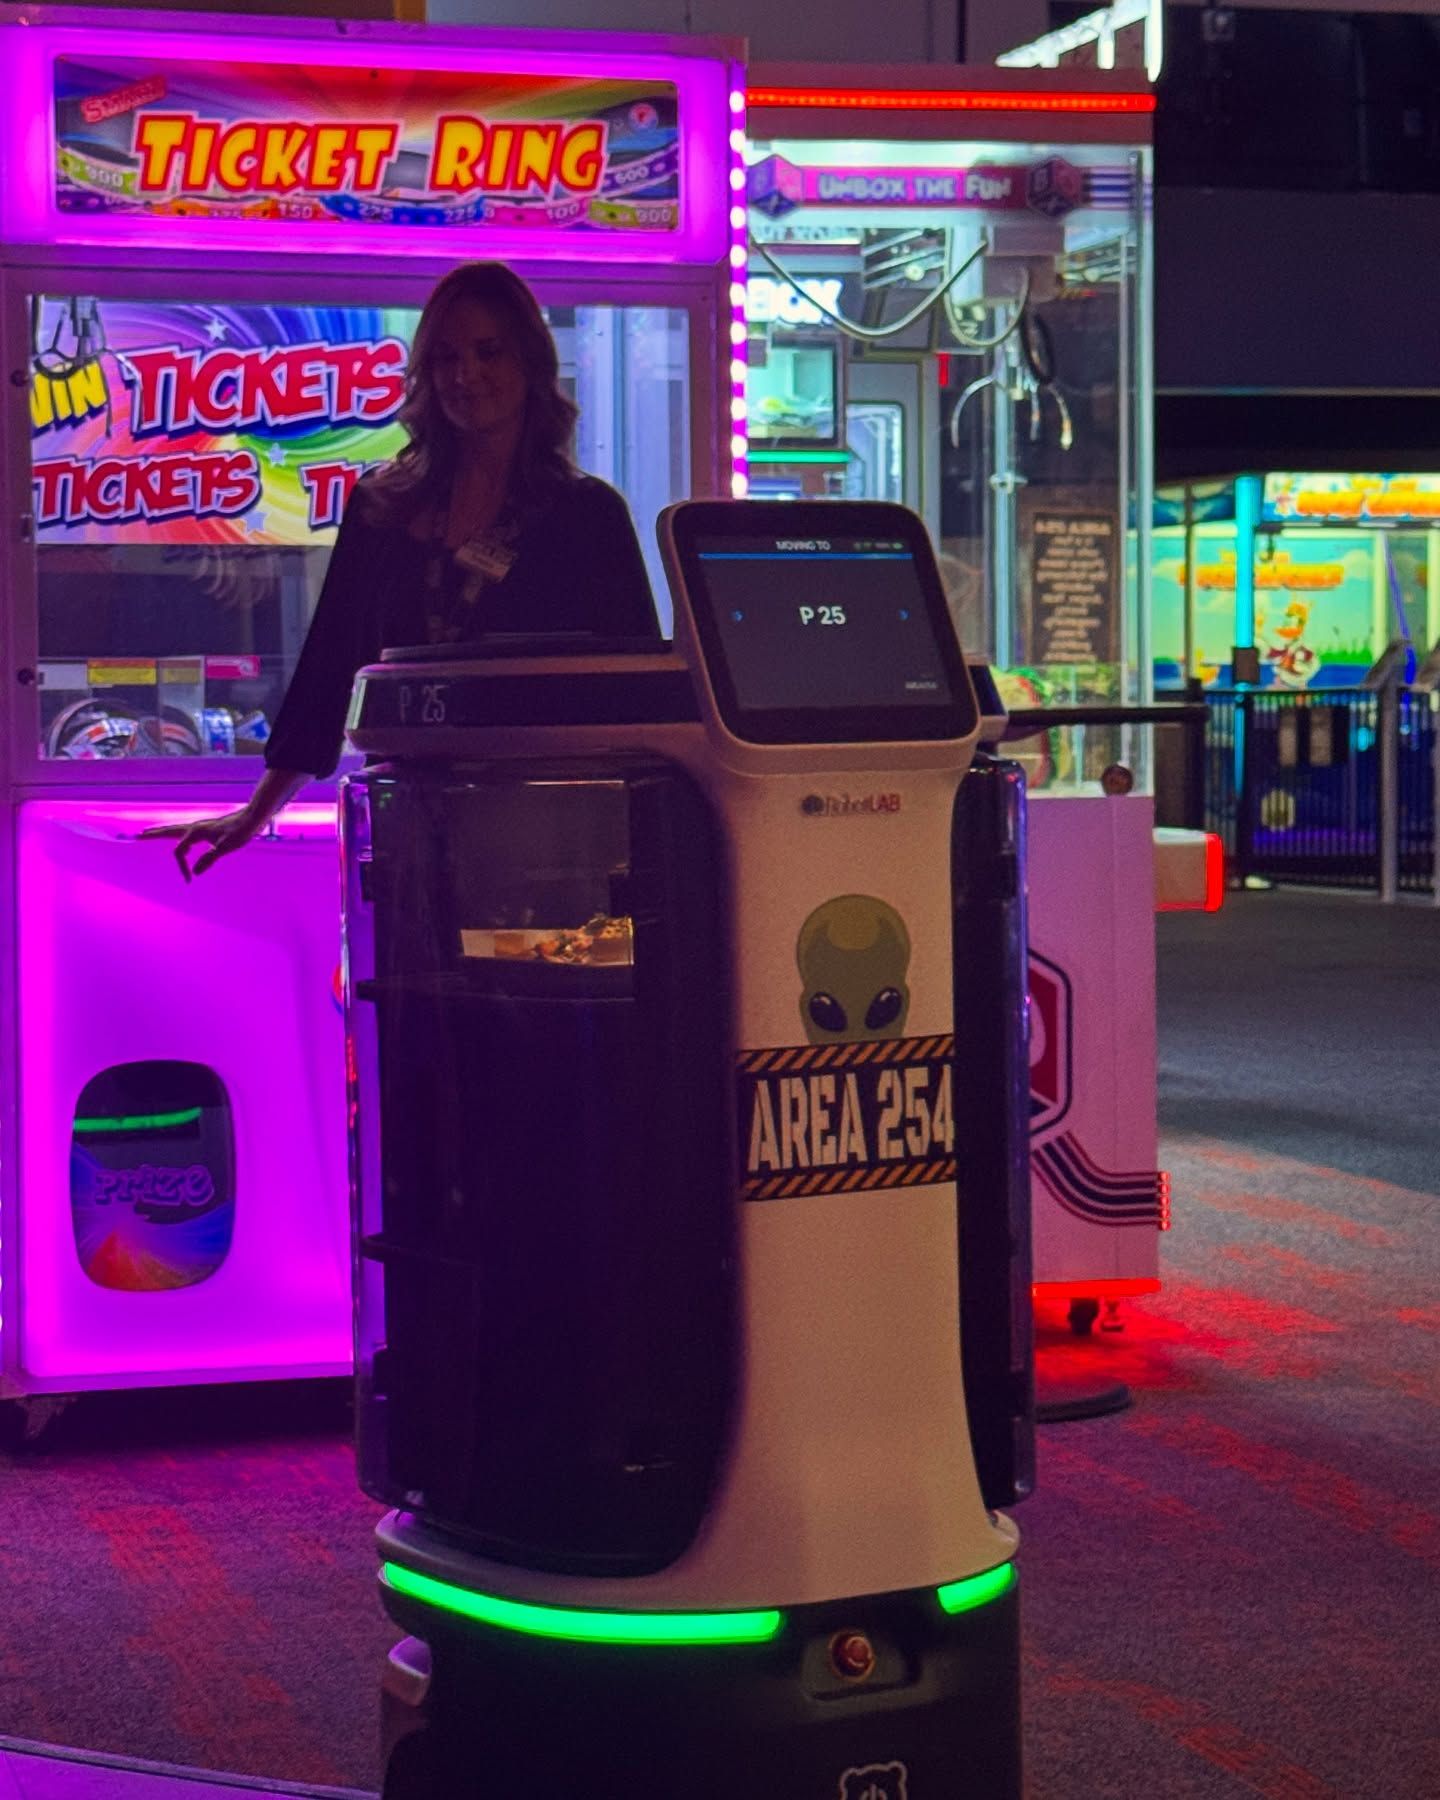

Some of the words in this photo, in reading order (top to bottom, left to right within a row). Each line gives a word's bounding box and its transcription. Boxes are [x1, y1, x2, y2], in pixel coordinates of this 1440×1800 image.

[136, 113, 396, 193] TICKET
[429, 113, 607, 196] RING
[914, 176, 957, 200] THE
[129, 341, 408, 429] TICKETS
[34, 449, 260, 521] TICKETS
[775, 540, 815, 551] MOVING
[816, 540, 831, 551] TO
[799, 606, 814, 626] P
[817, 606, 847, 626] 25
[399, 684, 412, 722] P
[421, 684, 450, 723] 25
[748, 1072, 868, 1172] AREA
[877, 1064, 955, 1161] 254
